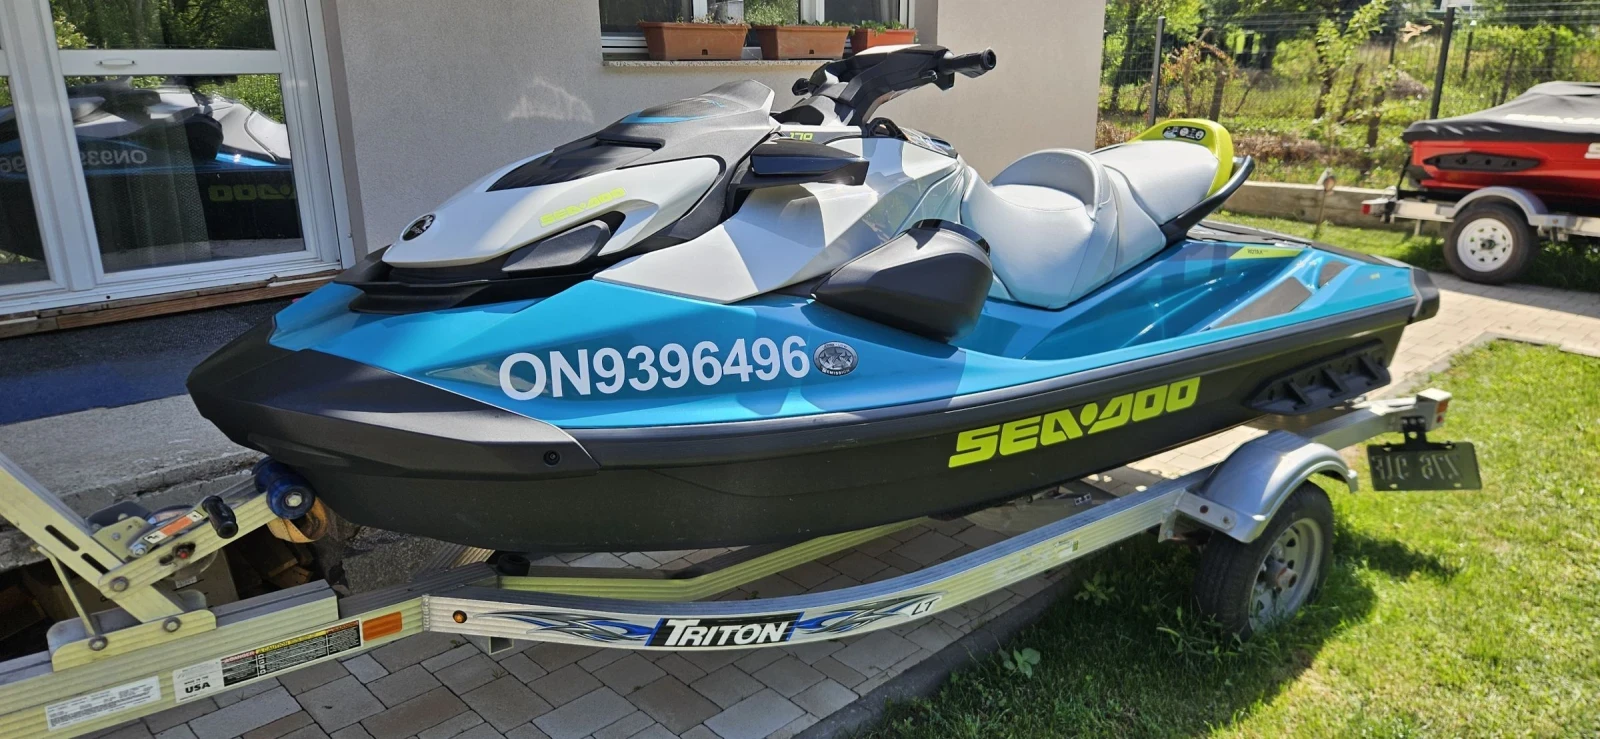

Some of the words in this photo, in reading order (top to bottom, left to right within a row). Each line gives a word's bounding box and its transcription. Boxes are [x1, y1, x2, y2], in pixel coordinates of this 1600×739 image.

[499, 335, 810, 401] ON9396496
[910, 598, 939, 616] LT
[664, 619, 788, 646] TRITON
[185, 681, 211, 694] USA
